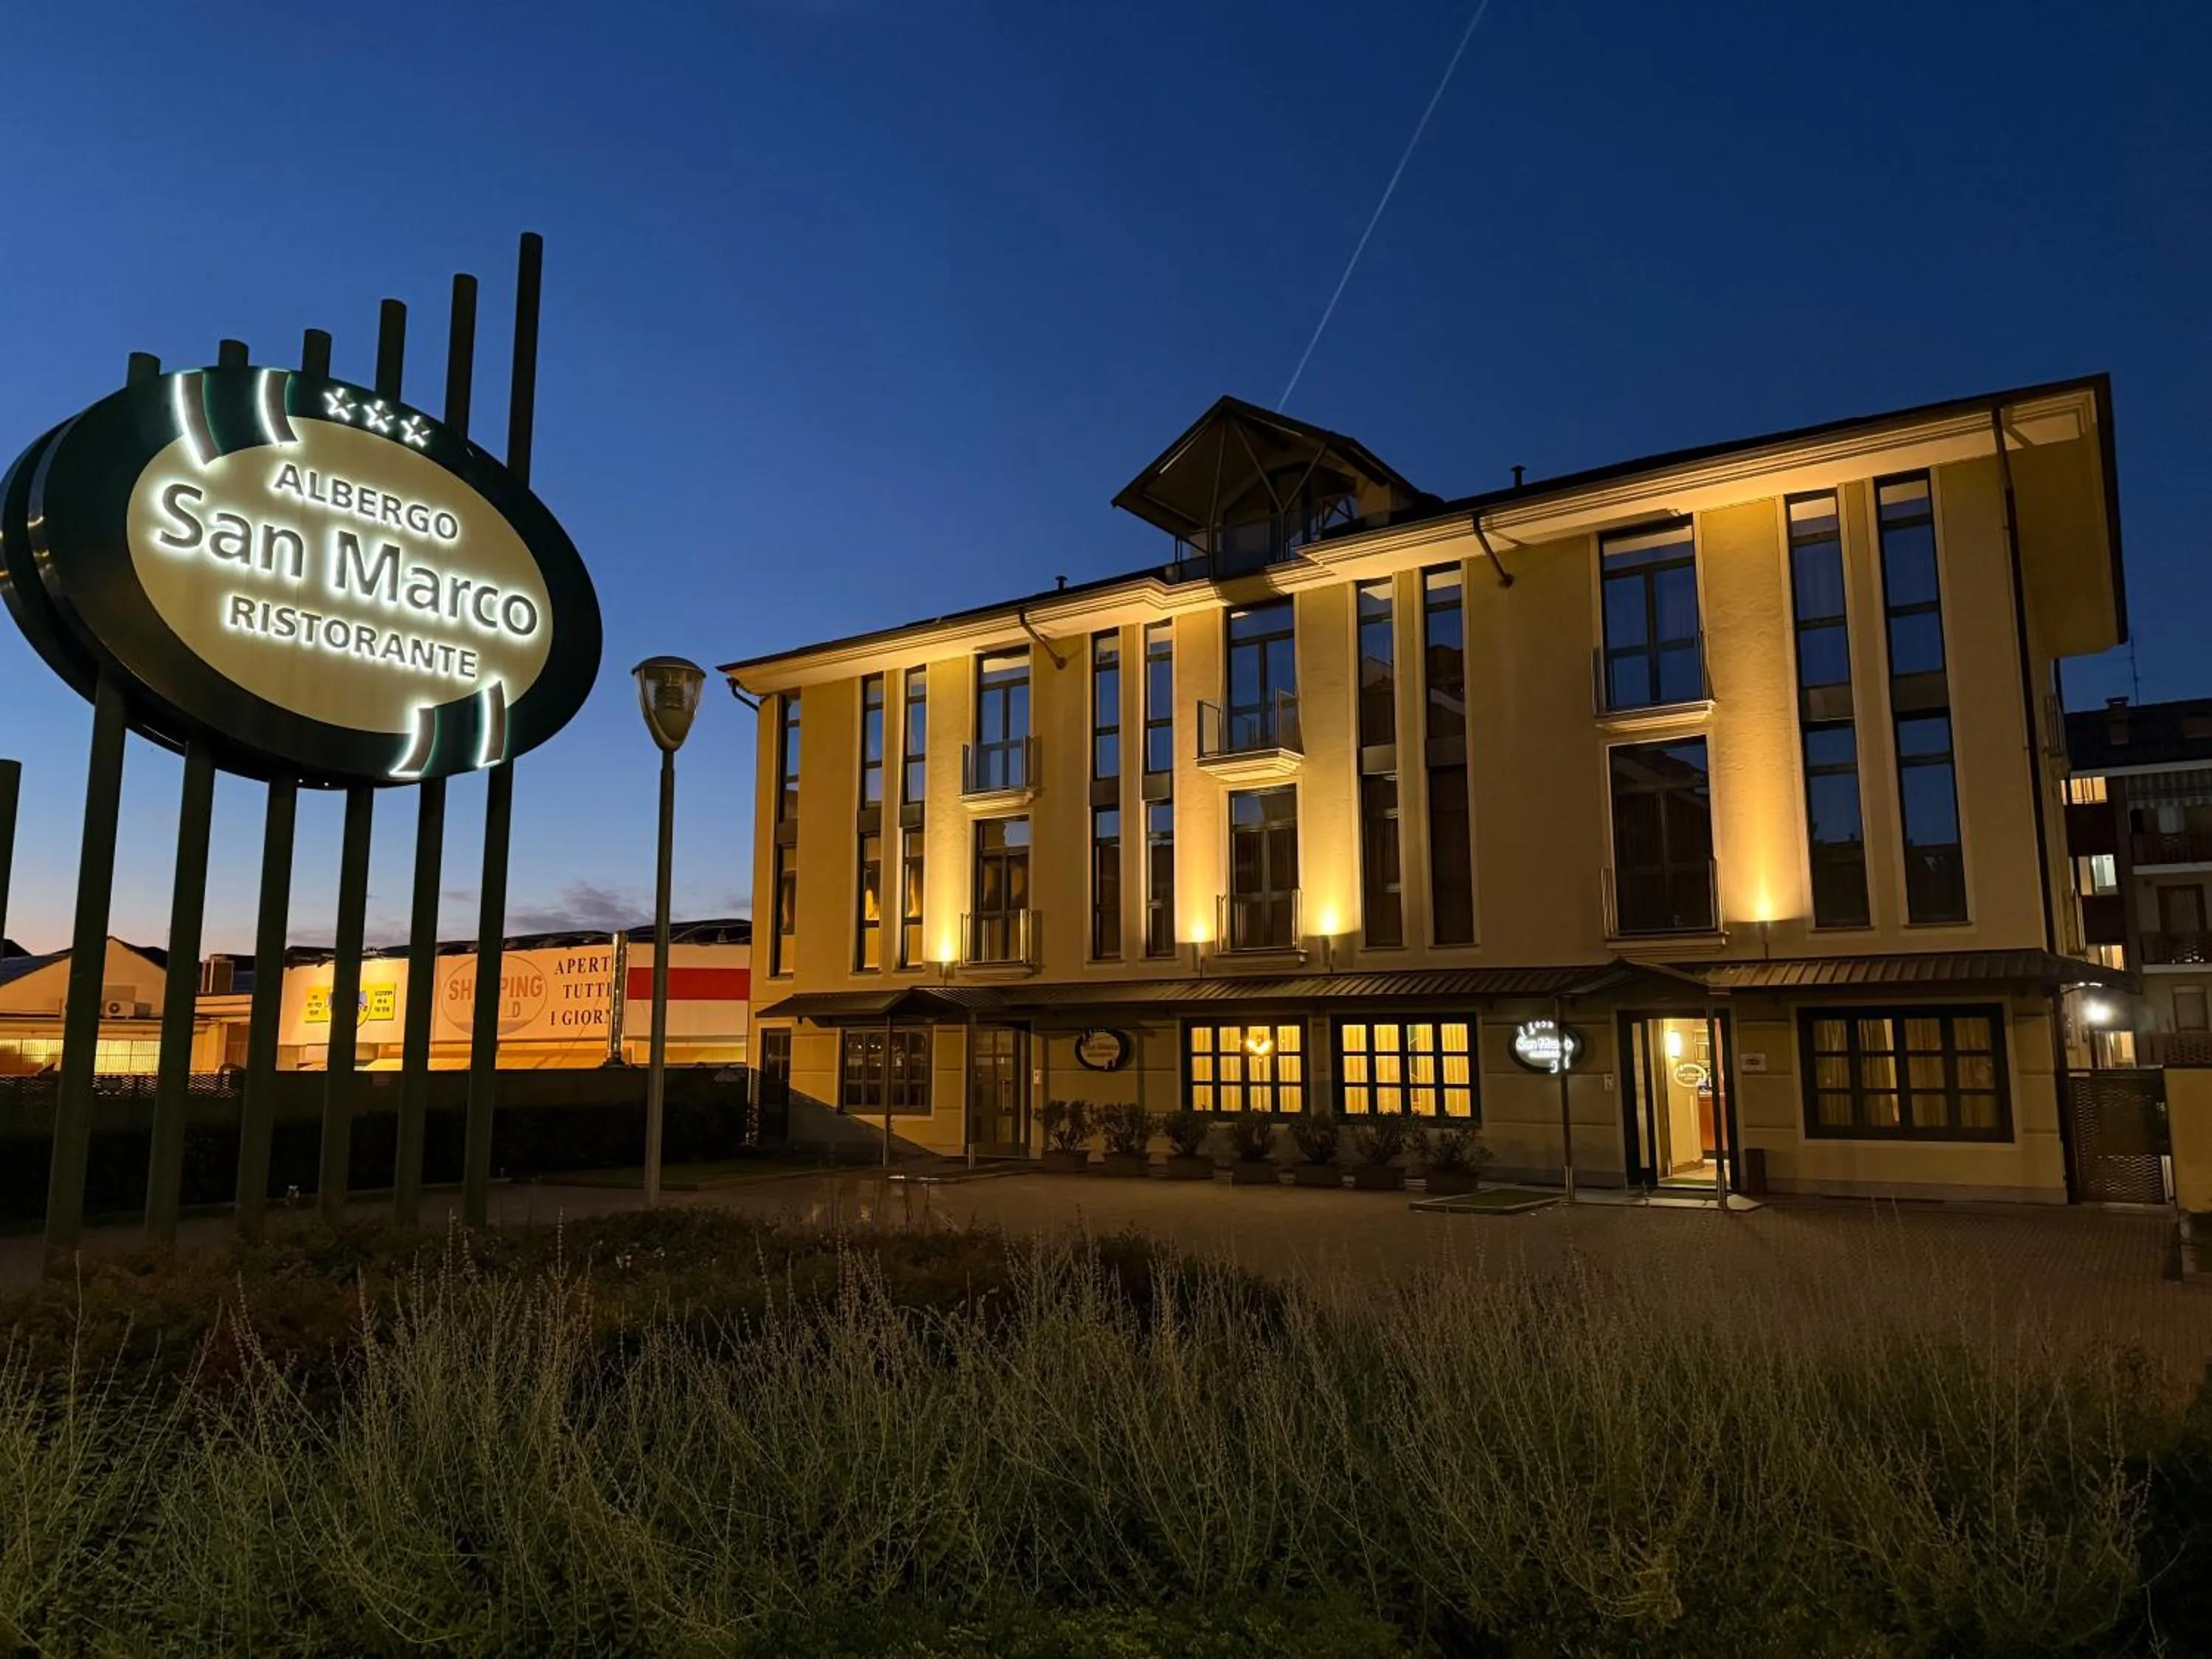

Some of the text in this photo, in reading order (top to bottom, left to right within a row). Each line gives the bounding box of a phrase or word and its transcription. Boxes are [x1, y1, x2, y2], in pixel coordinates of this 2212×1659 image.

[274, 463, 459, 540] ALBERGO
[159, 483, 538, 637] San Marco
[229, 595, 478, 678] RISTORANTE
[448, 975, 543, 1001] SHPING
[554, 956, 611, 975] APERT
[550, 1009, 610, 1026] I GIOR
